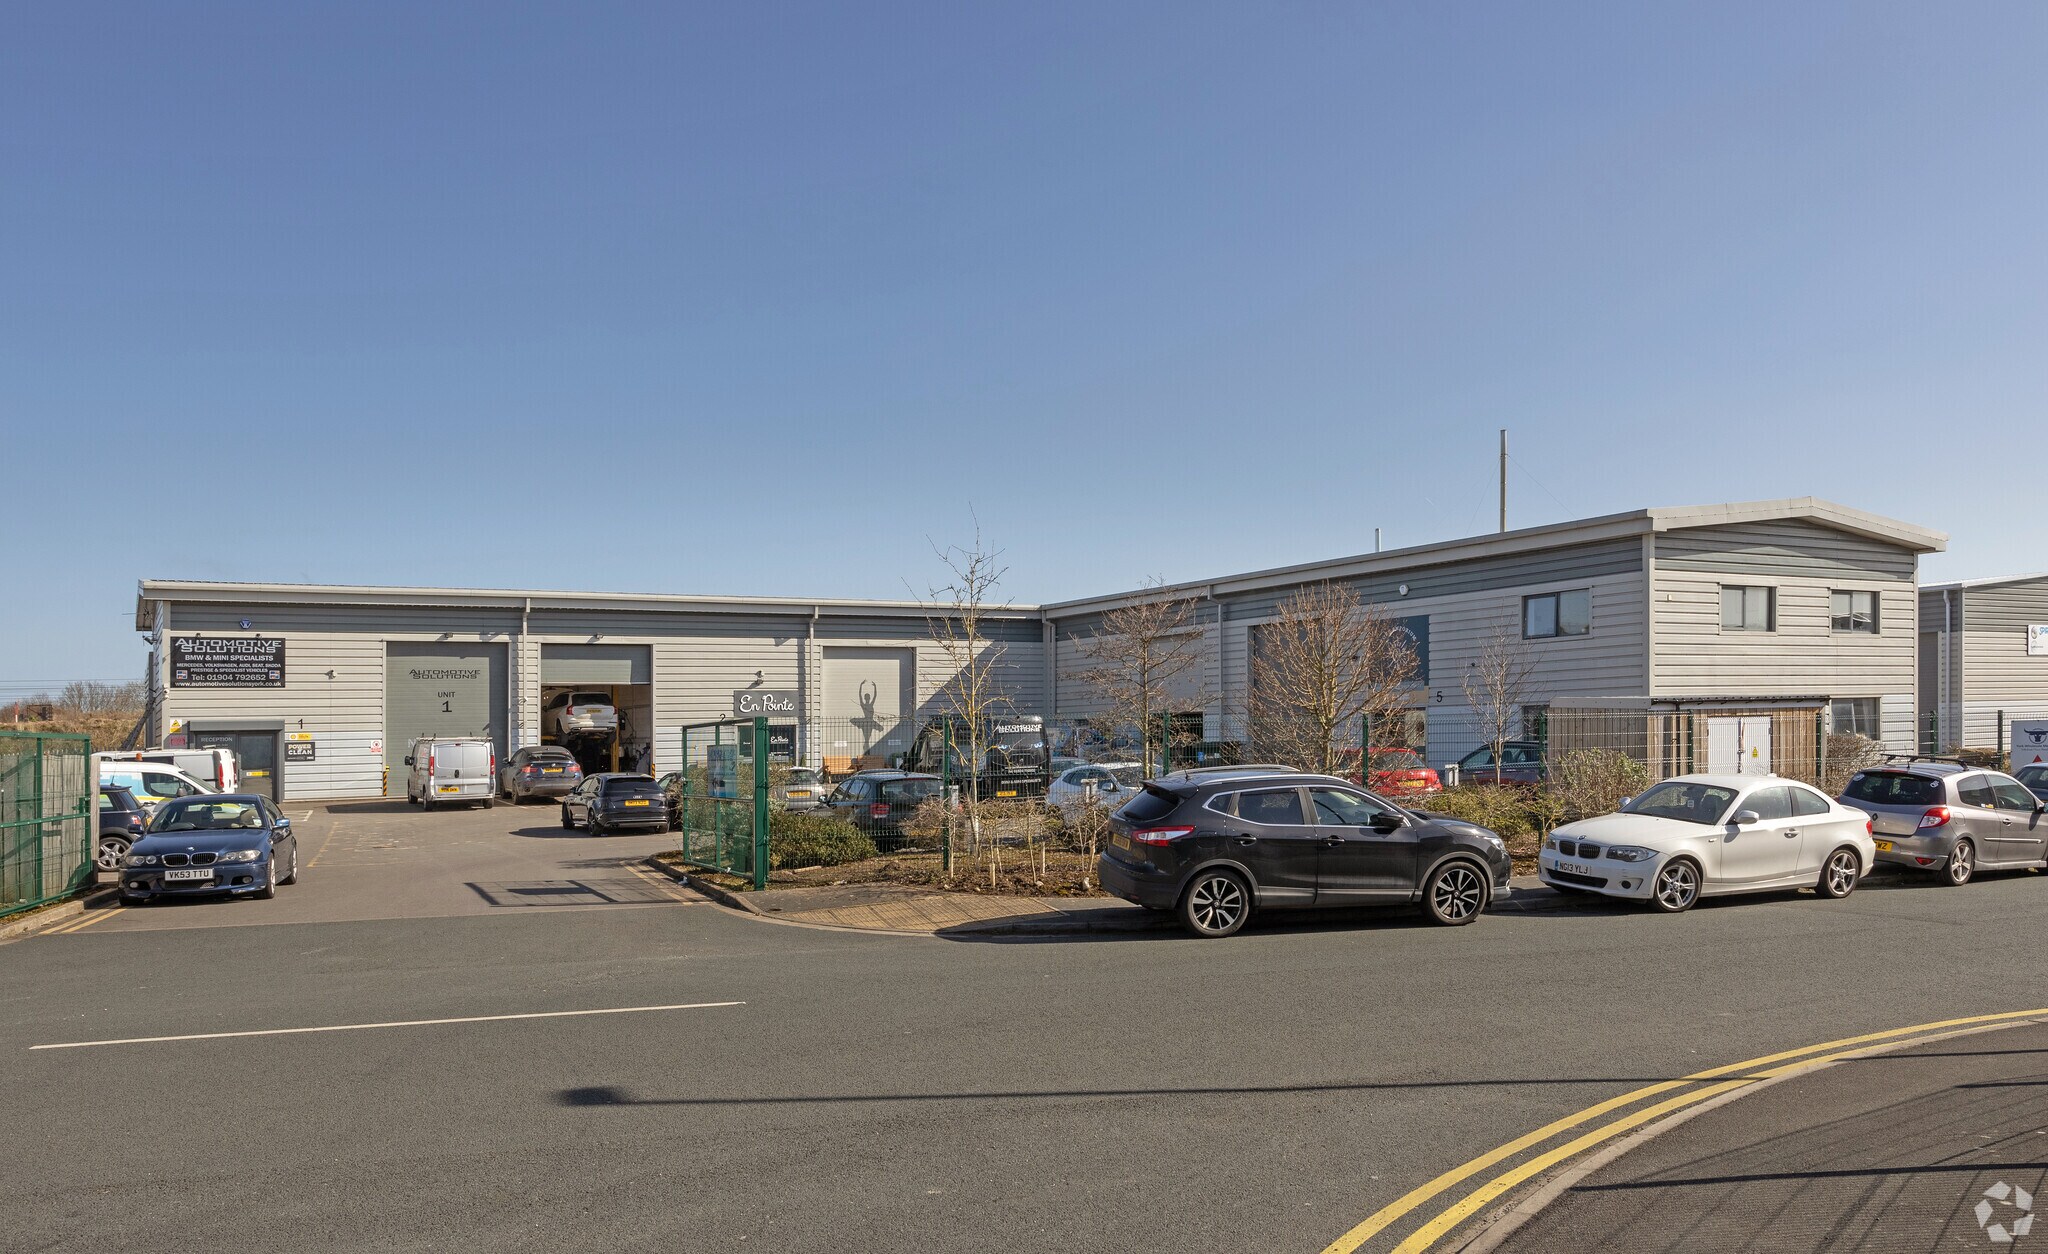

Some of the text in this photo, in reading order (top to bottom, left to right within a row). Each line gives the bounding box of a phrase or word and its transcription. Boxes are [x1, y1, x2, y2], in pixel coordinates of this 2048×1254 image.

[175, 638, 282, 647] AUTOMOTIVE
[1436, 691, 1442, 702] 5
[441, 700, 452, 712] 1
[740, 694, 795, 712] En Pointe
[298, 718, 303, 729] 1
[720, 714, 726, 722] 2
[1560, 862, 1588, 874] NG13 YLJ
